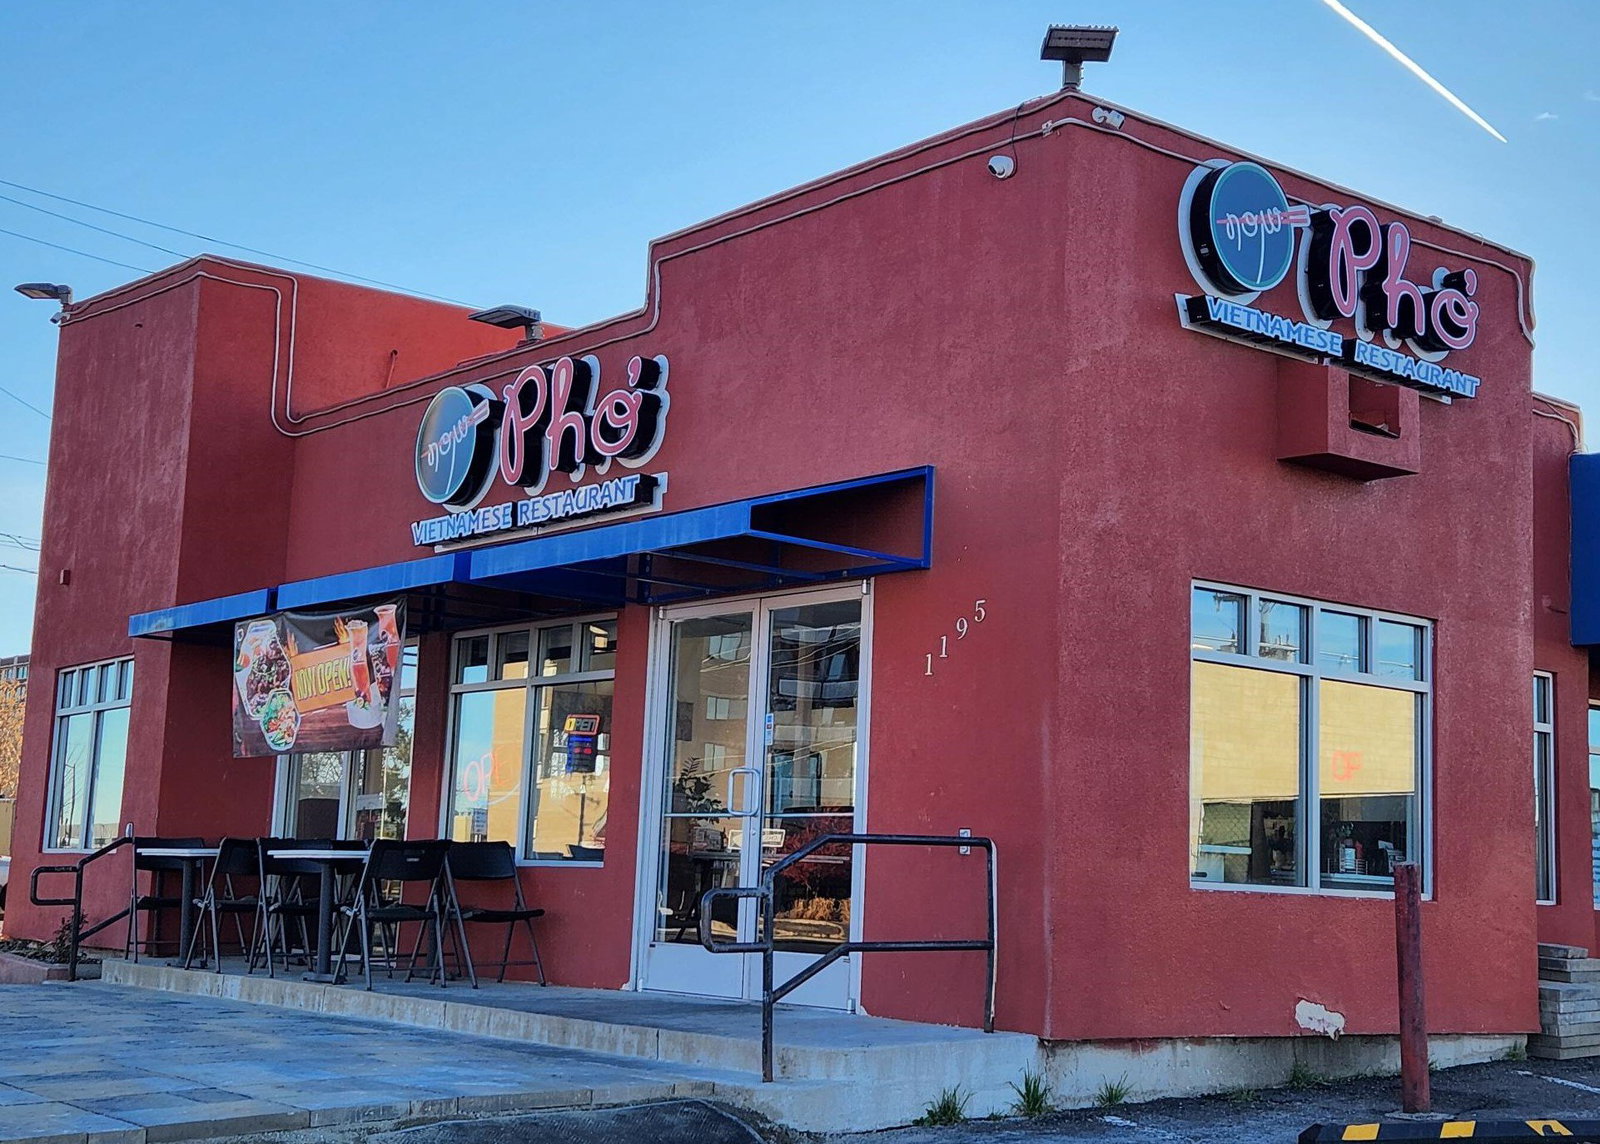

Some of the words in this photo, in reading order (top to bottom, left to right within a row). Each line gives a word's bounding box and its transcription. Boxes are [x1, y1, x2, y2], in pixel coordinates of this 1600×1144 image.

[1225, 206, 1283, 284] now
[1206, 296, 1342, 356] VIETNAMESE
[1355, 340, 1480, 396] RESTAURANT
[412, 503, 512, 544] VIETNAMESE
[518, 474, 640, 524] RESTAURANT
[924, 599, 986, 675] 1195
[317, 656, 352, 695] OPEN!
